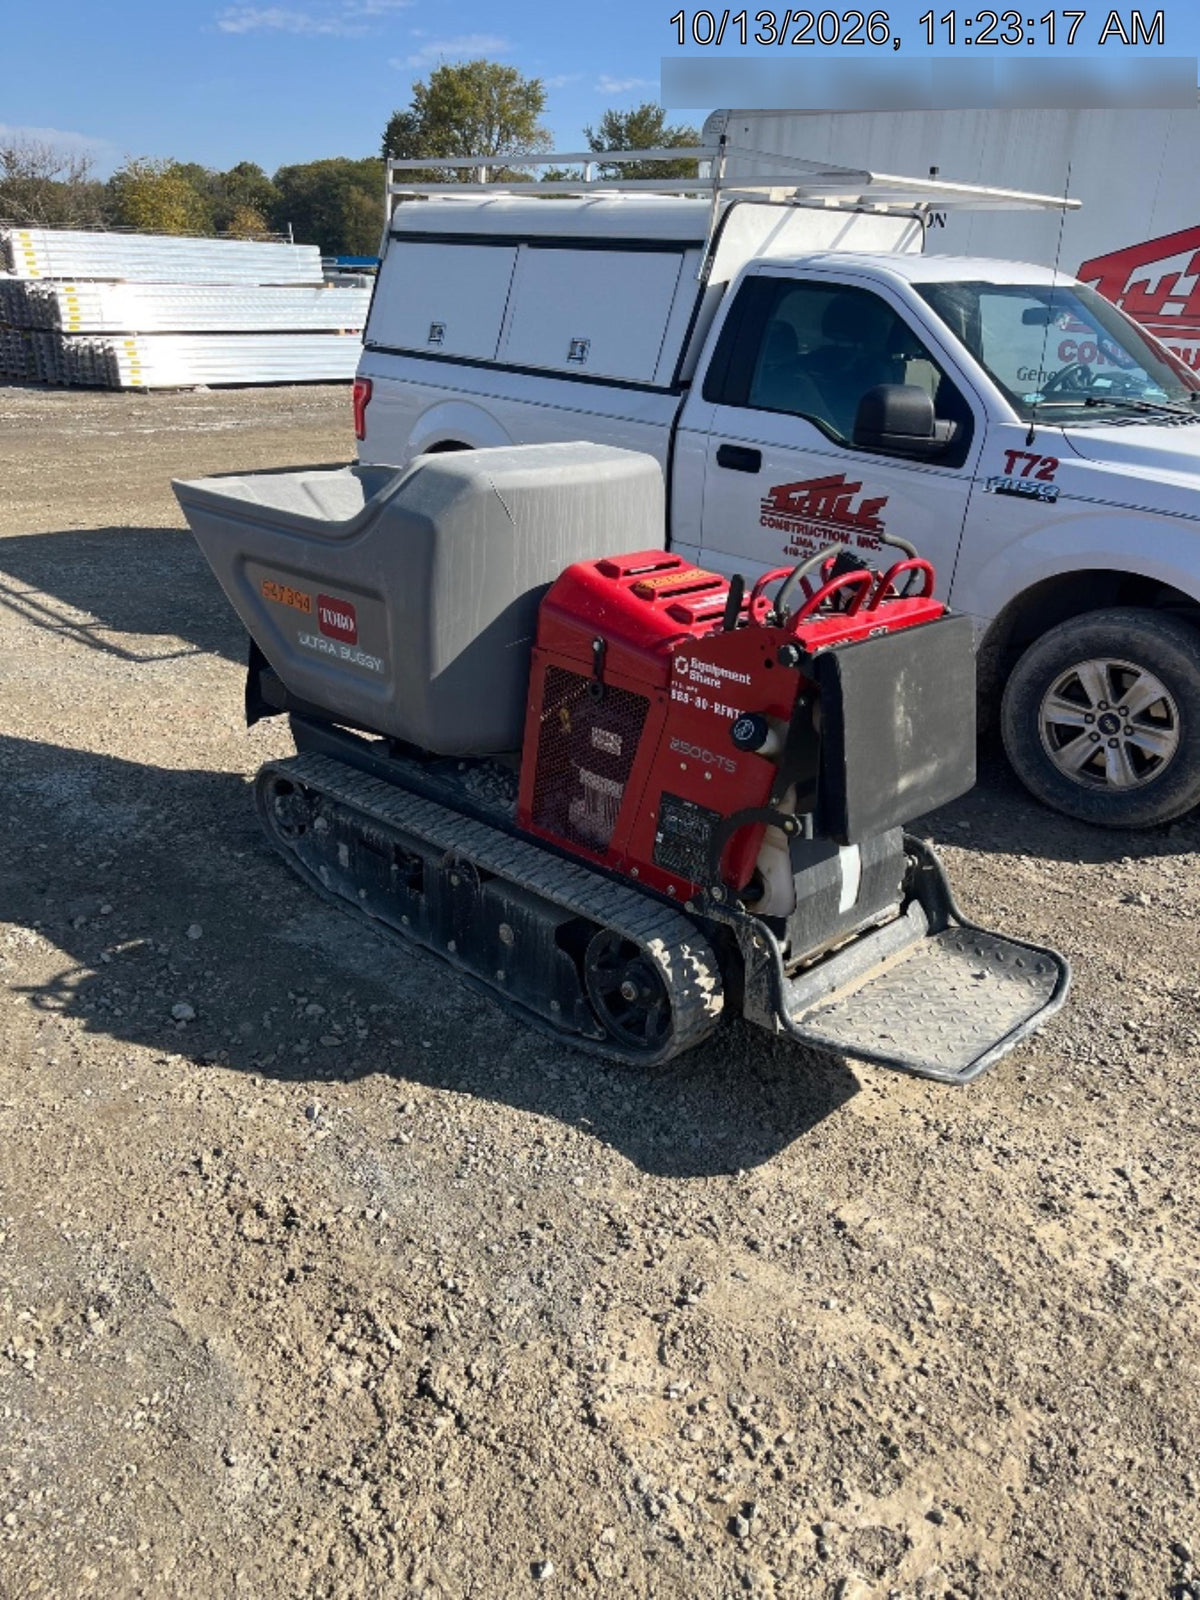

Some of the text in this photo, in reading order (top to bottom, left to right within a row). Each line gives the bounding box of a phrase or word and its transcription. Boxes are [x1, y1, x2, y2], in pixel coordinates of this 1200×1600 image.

[1004, 449, 1060, 481] T72
[768, 473, 889, 529] TUTTLE
[319, 607, 355, 632] TORO
[298, 631, 384, 672] ULTRA BUGGY
[688, 669, 722, 689] Share
[689, 656, 752, 686] Equipment
[669, 737, 737, 773] 2500-TS
